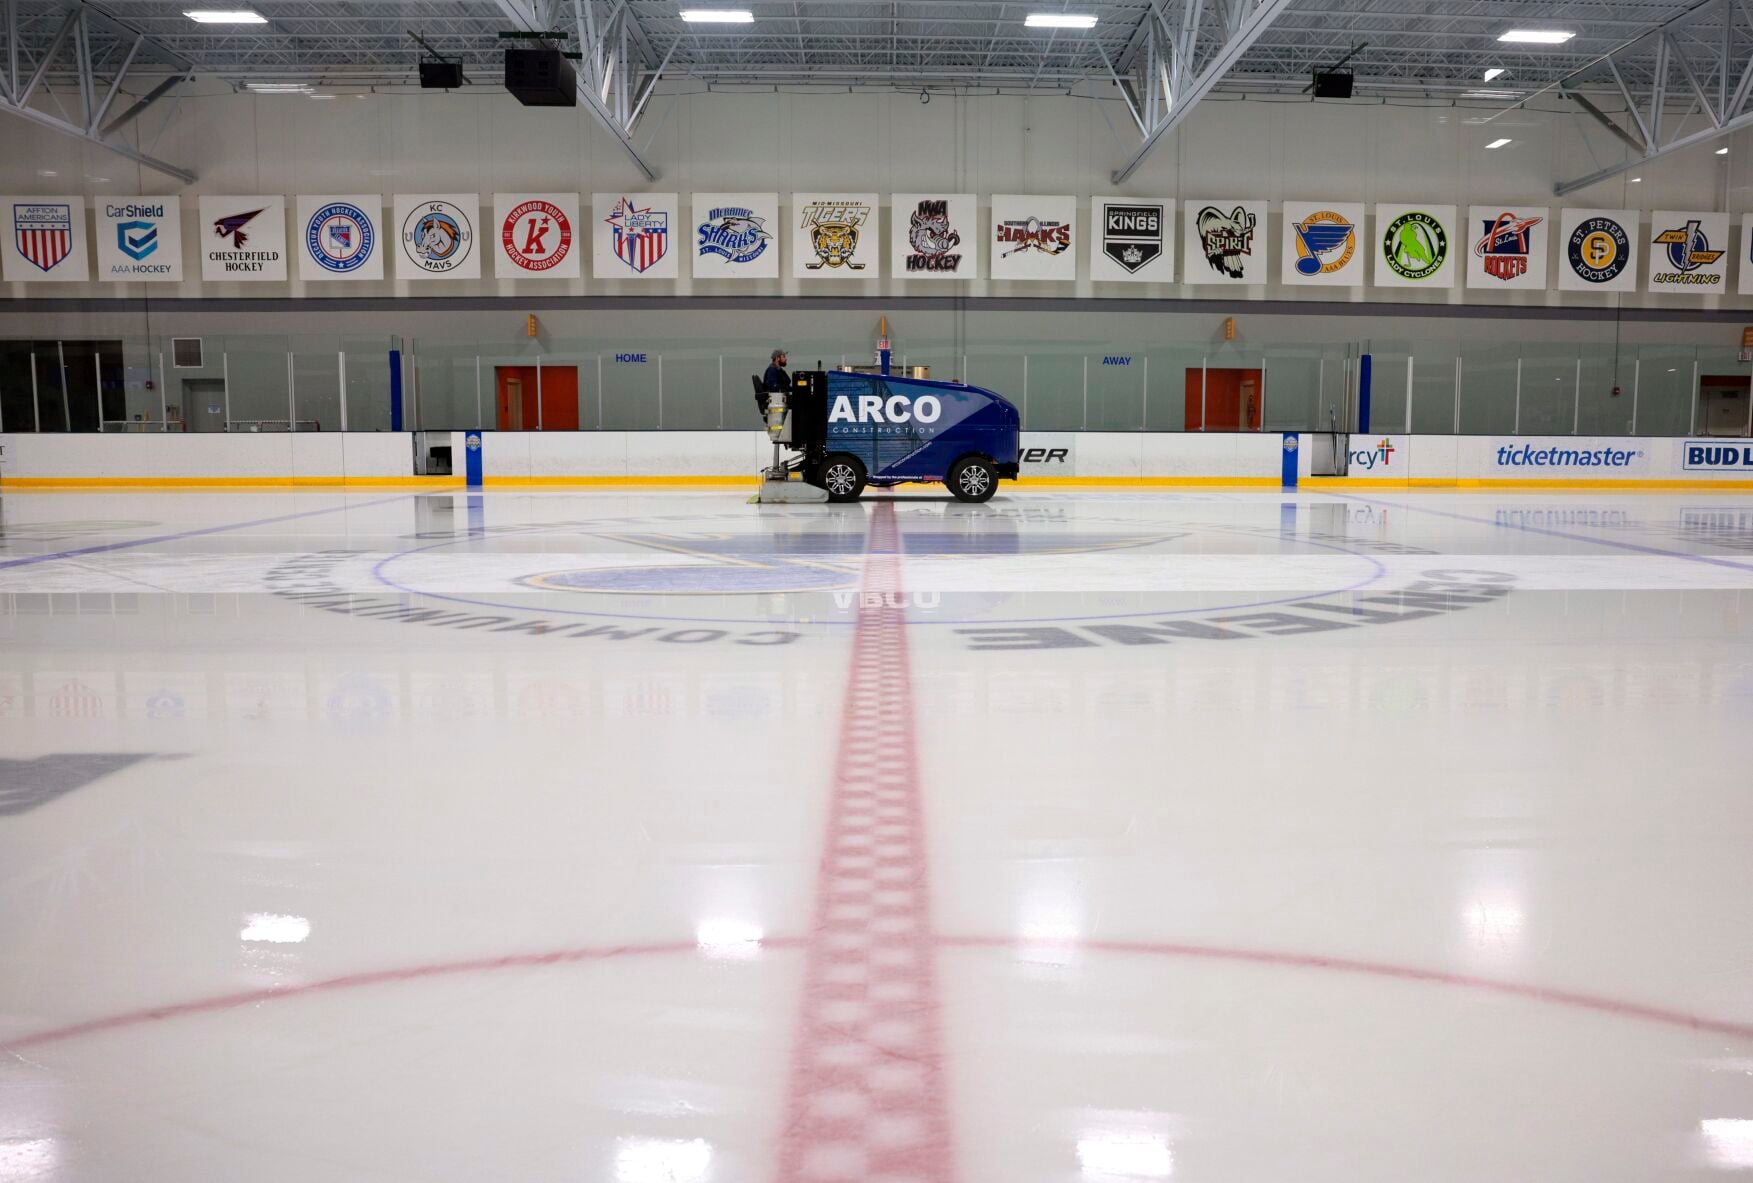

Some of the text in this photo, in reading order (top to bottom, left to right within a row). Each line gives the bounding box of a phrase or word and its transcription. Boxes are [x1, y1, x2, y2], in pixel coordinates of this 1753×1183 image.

[429, 204, 443, 212] KC
[508, 202, 565, 224] KIRKWOOD YOUTH
[800, 205, 871, 229] TIGERS
[1321, 212, 1344, 223] LOUIS
[313, 210, 331, 228] YOUTH
[331, 207, 358, 218] HOCKEY
[356, 216, 370, 259] ASSOCIATION
[1108, 216, 1158, 231] KINGS
[1390, 214, 1442, 234] ST. LOUIS
[1573, 220, 1626, 245] ST. PETERS
[698, 223, 758, 249] SHARKS
[209, 252, 279, 261] CHESTERFIELD
[424, 260, 452, 270] MAVS
[505, 243, 569, 269] HOCKEY ASSOCIATION
[907, 254, 962, 271] HOCKEY
[111, 264, 172, 273] AAA HOCKEY
[225, 262, 264, 272] HOCKEY
[1387, 254, 1443, 278] LADY CYCLONES
[1484, 255, 1528, 281] ROCKETS
[1576, 262, 1618, 280] HOCKEY
[1653, 272, 1721, 284] LIGHTNING
[615, 354, 647, 363] HOME
[1102, 356, 1132, 365] AWAY
[828, 395, 942, 424] ARCO
[1497, 444, 1636, 467] ticketmaster
[1688, 447, 1739, 465] BUD
[953, 568, 1518, 650] CENTENE
[302, 599, 802, 645] COMMUNITY
